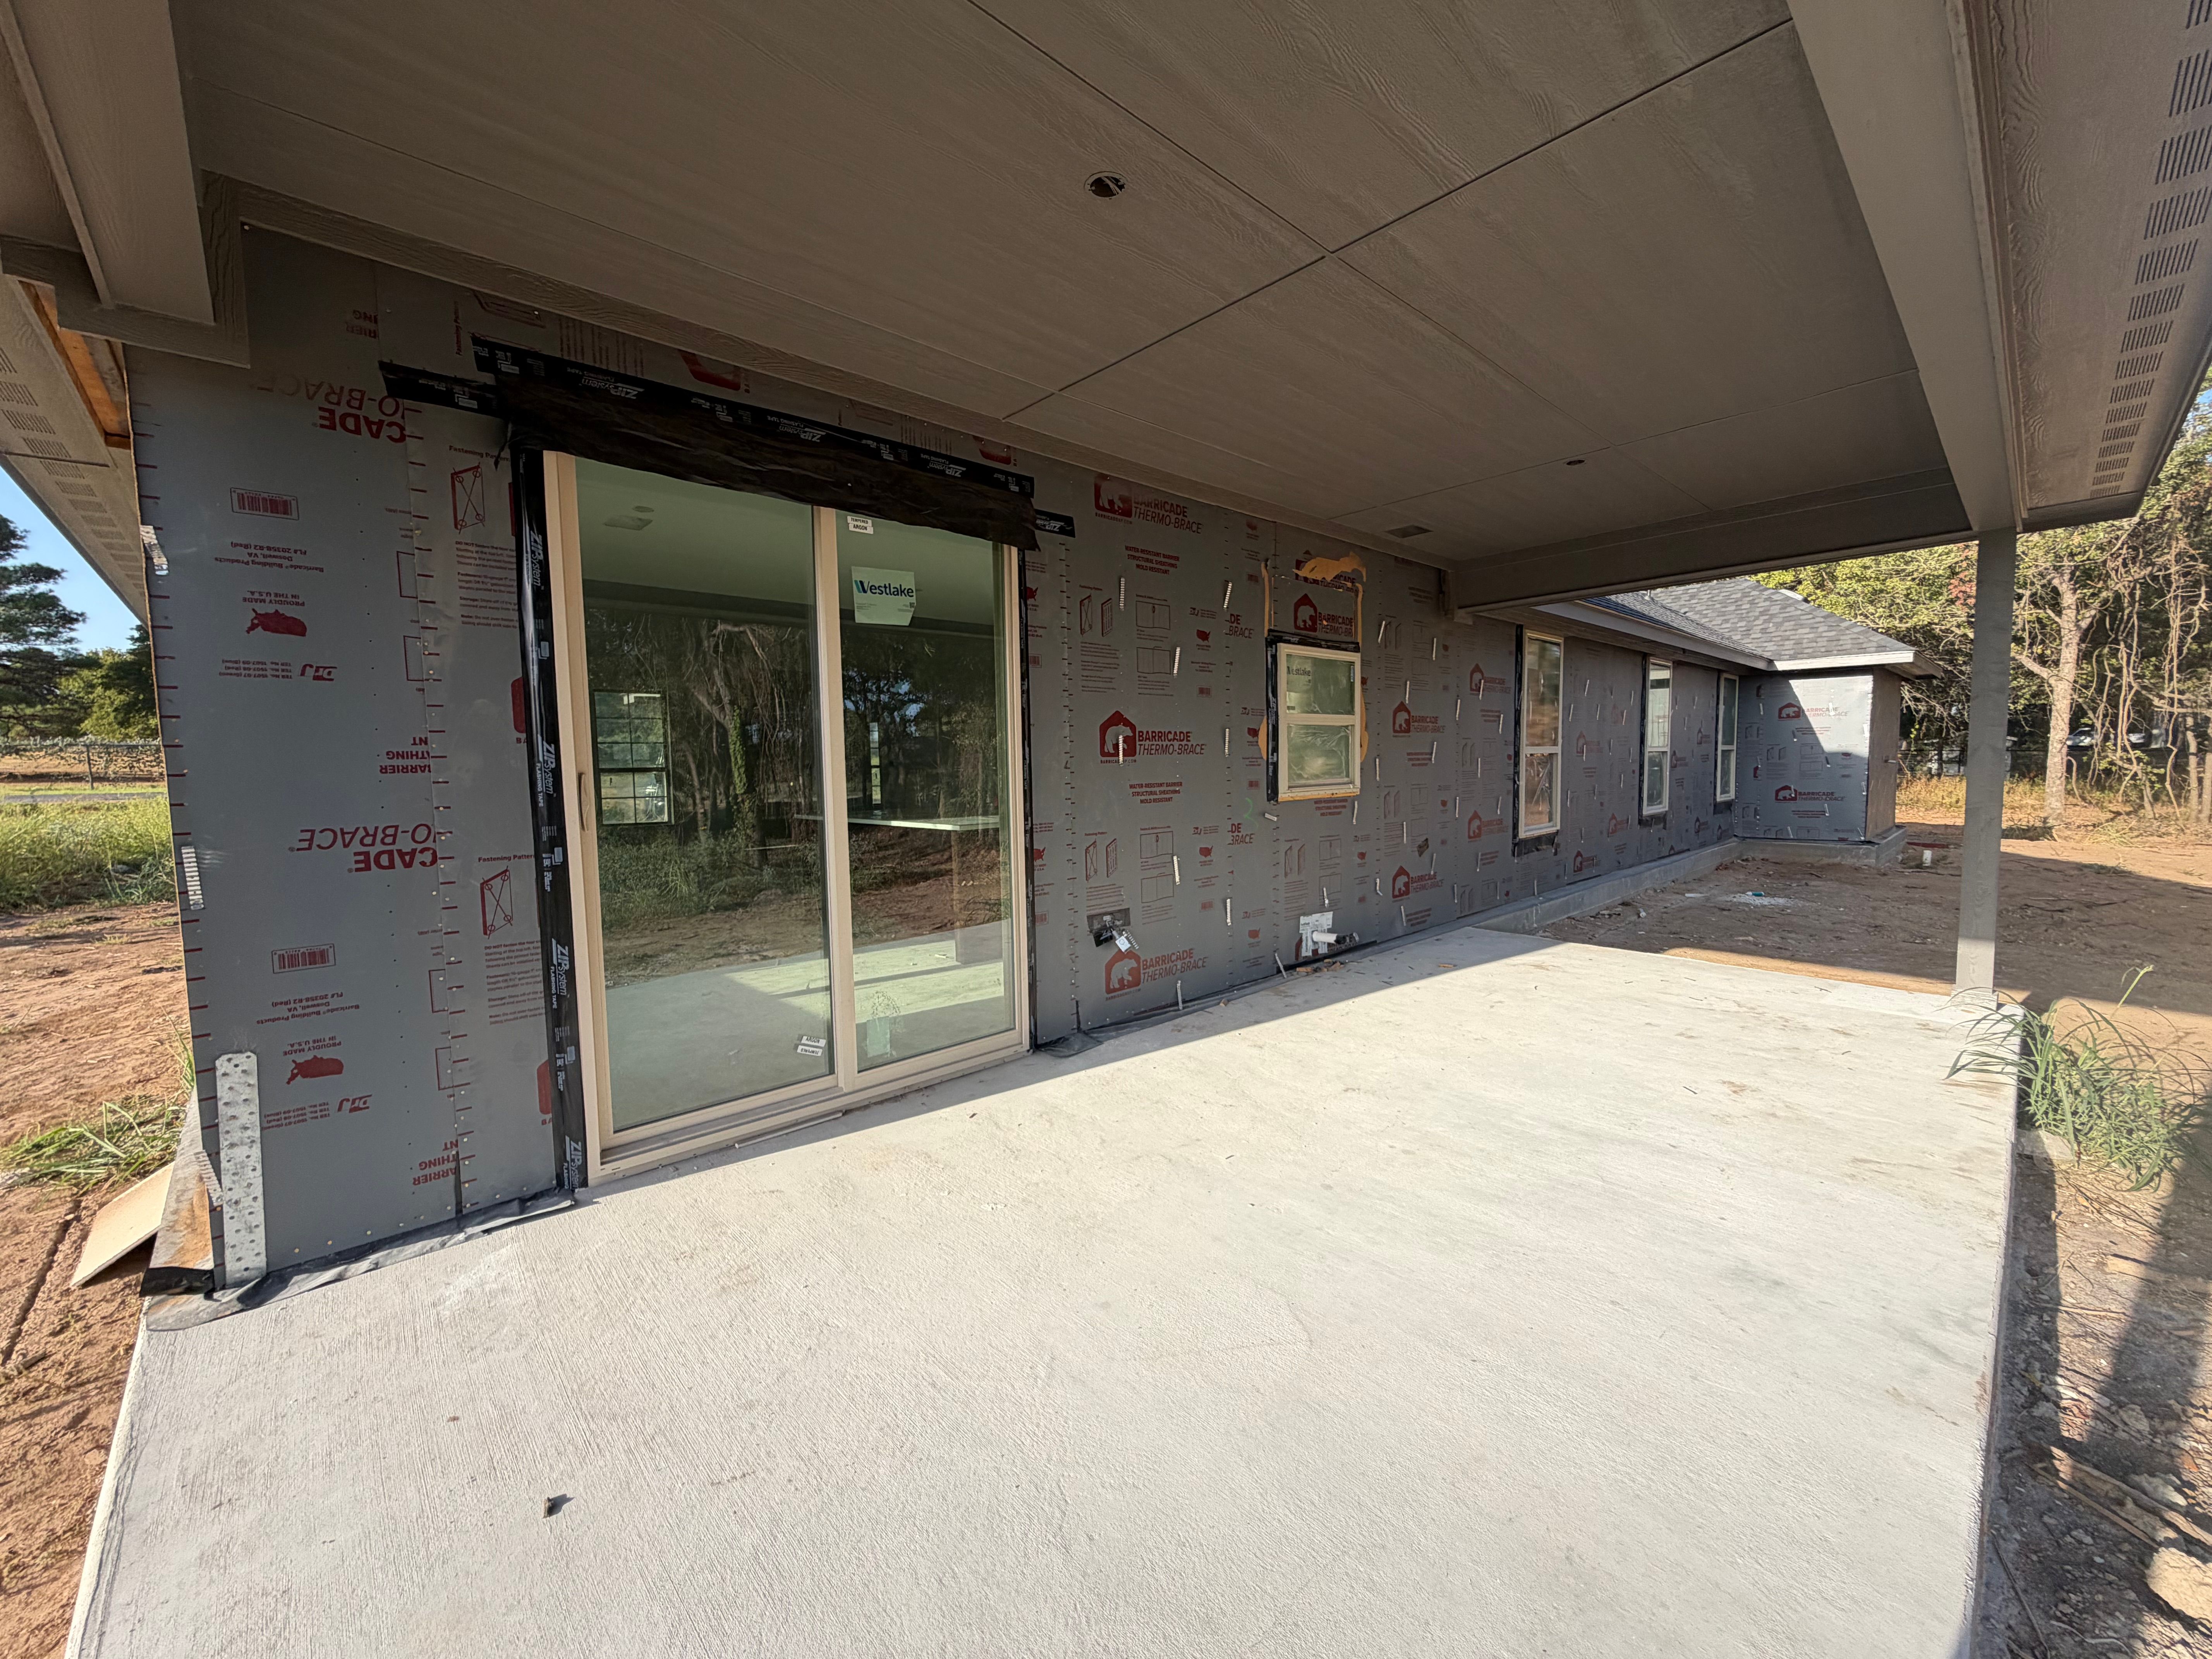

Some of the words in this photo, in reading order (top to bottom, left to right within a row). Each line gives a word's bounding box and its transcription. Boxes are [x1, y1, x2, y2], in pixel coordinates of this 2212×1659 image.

[485, 452, 510, 462] Paern
[1133, 506, 1202, 534] THERMO-BRACE
[1125, 545, 1162, 558] WATER-RESISTANT
[1163, 553, 1180, 562] BARRIER
[215, 557, 249, 565] Products
[252, 560, 283, 568] Building
[1127, 554, 1154, 564] STRUCTURAL
[1155, 560, 1178, 568] SHEATHING
[1149, 566, 1170, 575] RESISTANT
[854, 580, 914, 598] Westlake
[1318, 612, 1353, 626] BARRICADE
[1229, 625, 1254, 639] BRACE
[300, 664, 337, 682] DrJ
[1411, 715, 1439, 724] BARRICADE
[1138, 731, 1191, 742] BARRICADE
[1138, 743, 1205, 756] THERMO-BRACE
[1231, 823, 1242, 833] DE
[296, 823, 437, 851] O-BRACE
[353, 847, 438, 872] CADE
[1142, 948, 1195, 970] BARRICADE
[1142, 957, 1208, 984] THERMO-BRACE
[272, 999, 291, 1008] (Red)
[293, 994, 329, 1003] 20358-R2
[299, 1001, 330, 1010] Doswell,
[256, 1015, 289, 1025] Products
[291, 1010, 321, 1020] Building
[287, 1040, 310, 1049] U.S.A.
[307, 1041, 342, 1052] PROUDLY
[283, 1047, 305, 1056] MADE
[337, 1094, 372, 1114] DrJ
[442, 1139, 459, 1151] NT
[412, 1167, 456, 1186] ARRIER
